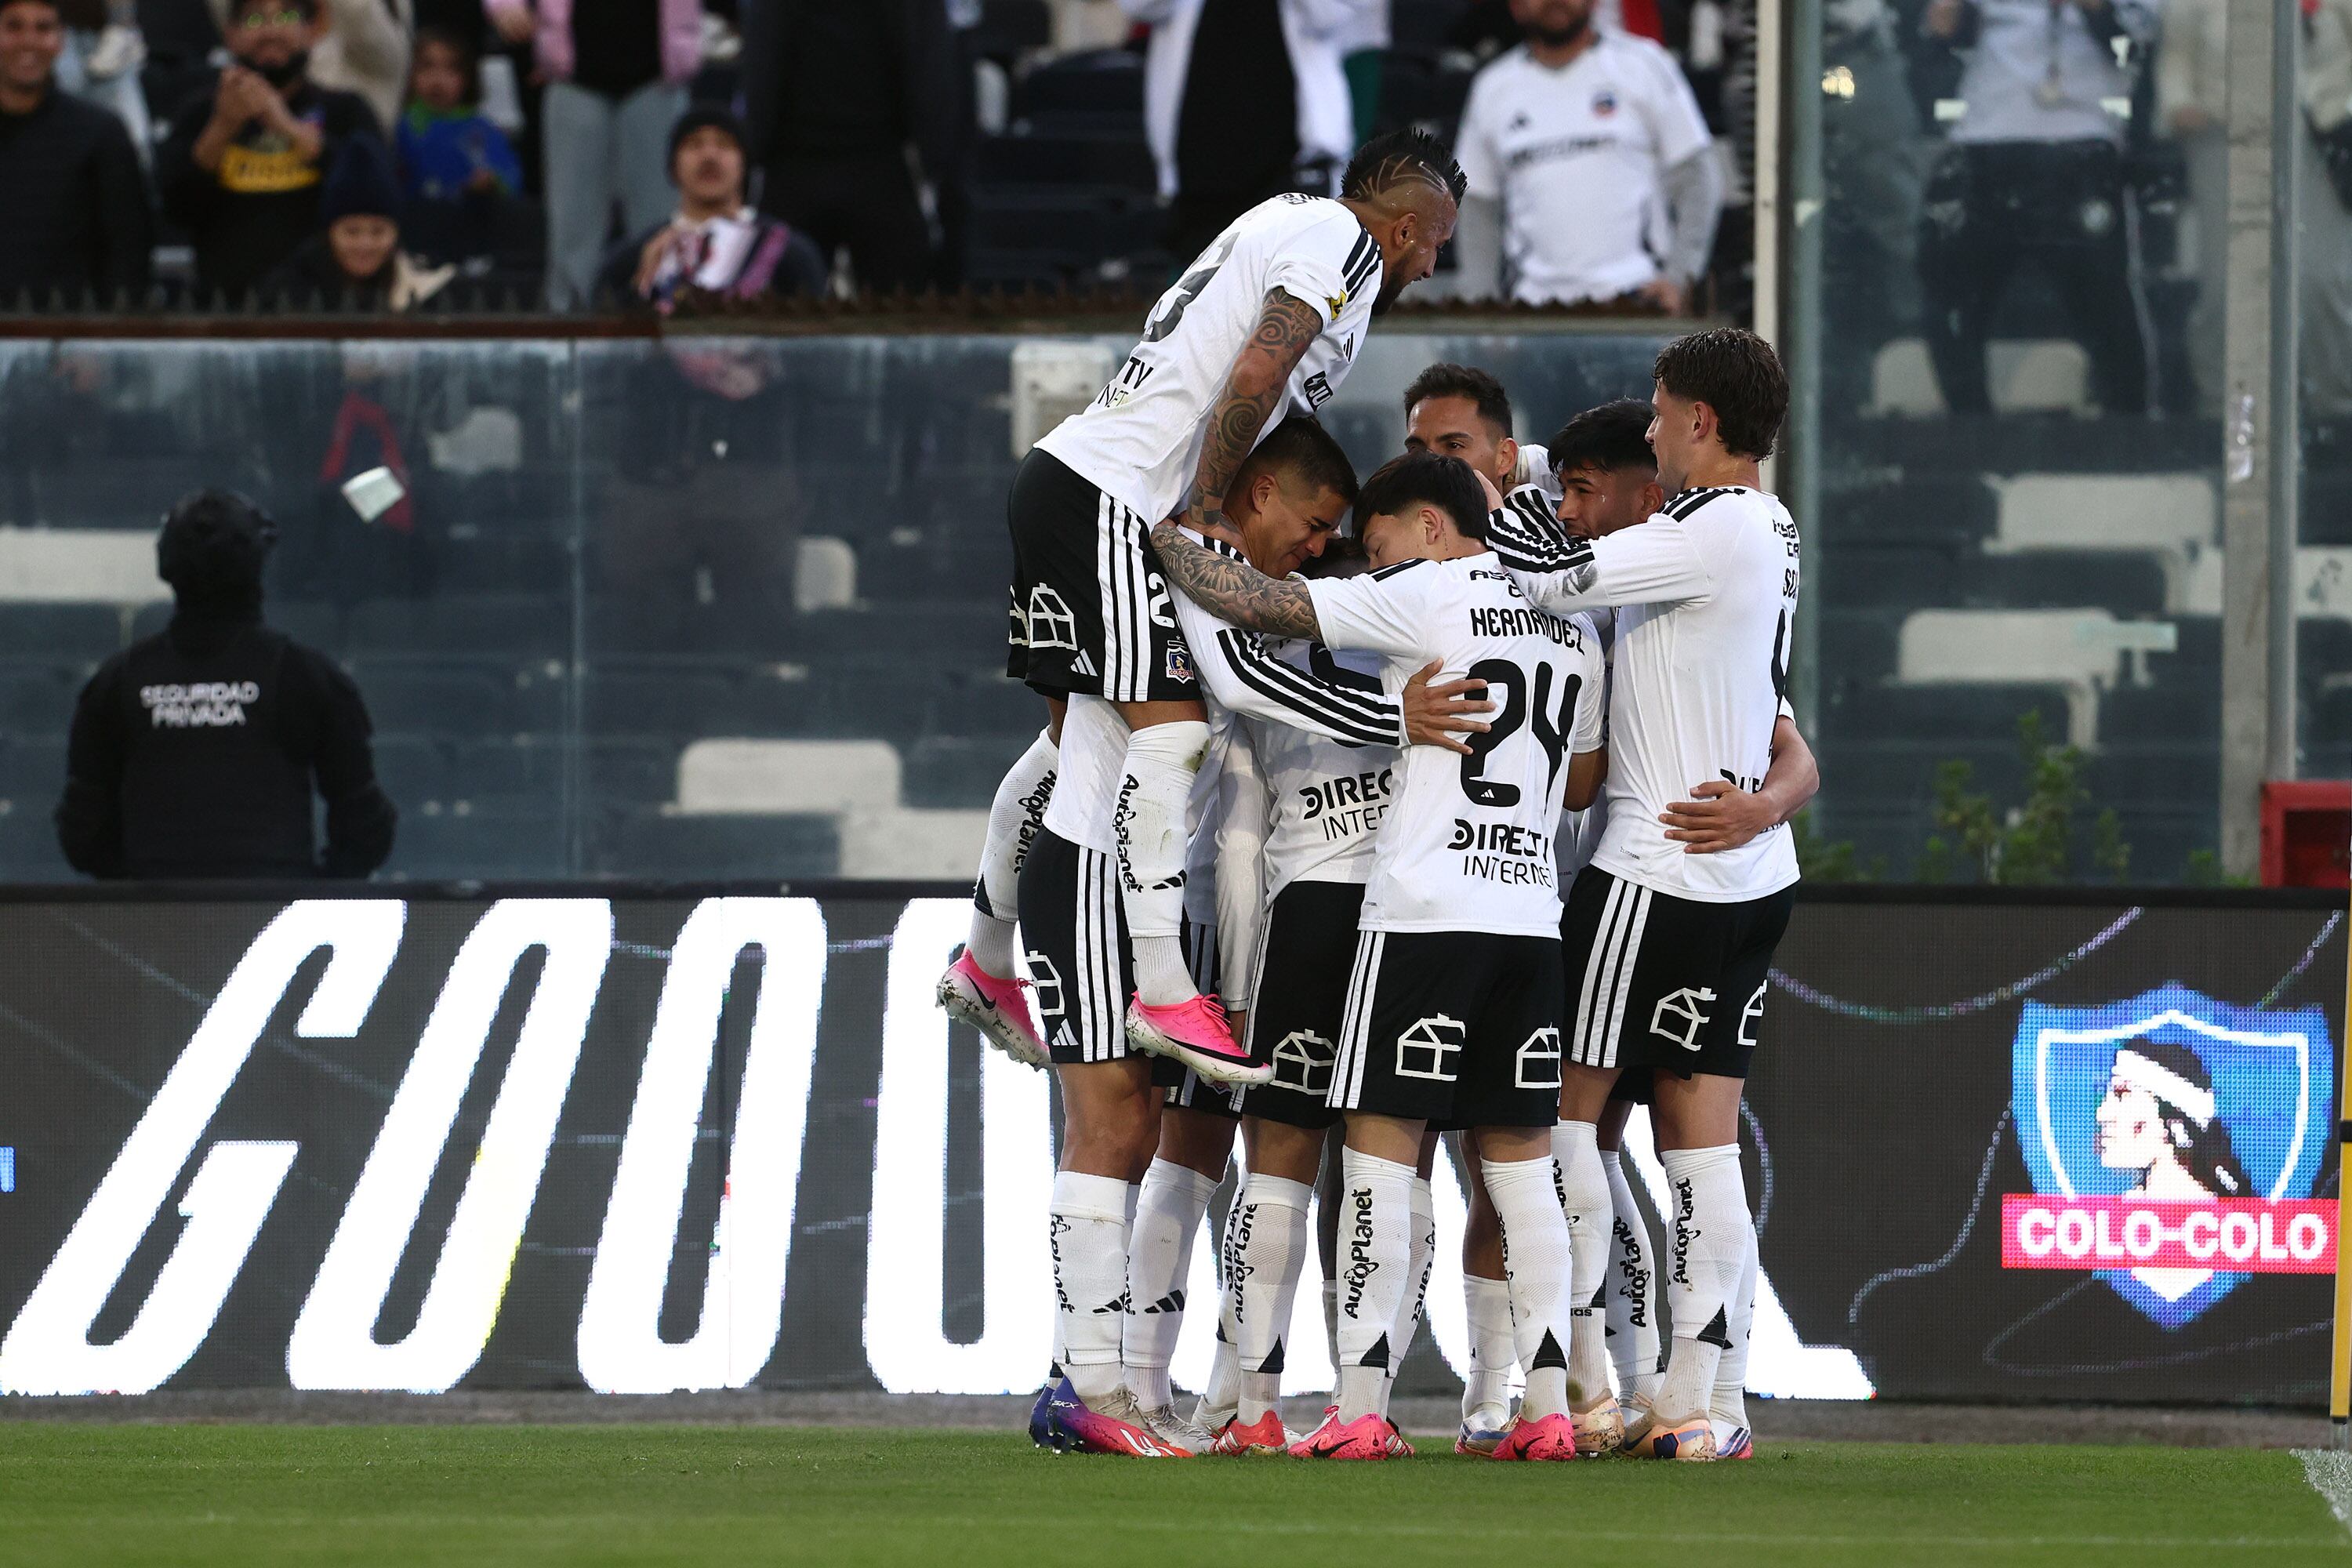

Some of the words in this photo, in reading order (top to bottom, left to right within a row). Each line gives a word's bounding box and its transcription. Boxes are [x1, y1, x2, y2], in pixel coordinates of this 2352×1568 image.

[1148, 572, 1182, 629] 2
[1469, 607, 1585, 655] HERNANDEZ
[140, 681, 260, 708] SEGURIDAD
[151, 703, 247, 728] PRIVADA
[1461, 659, 1582, 815] 24
[1344, 1187, 1380, 1319] AutoPlanet
[2018, 1207, 2328, 1262] COLO-COLO
[1051, 1399, 1080, 1409] SKX
